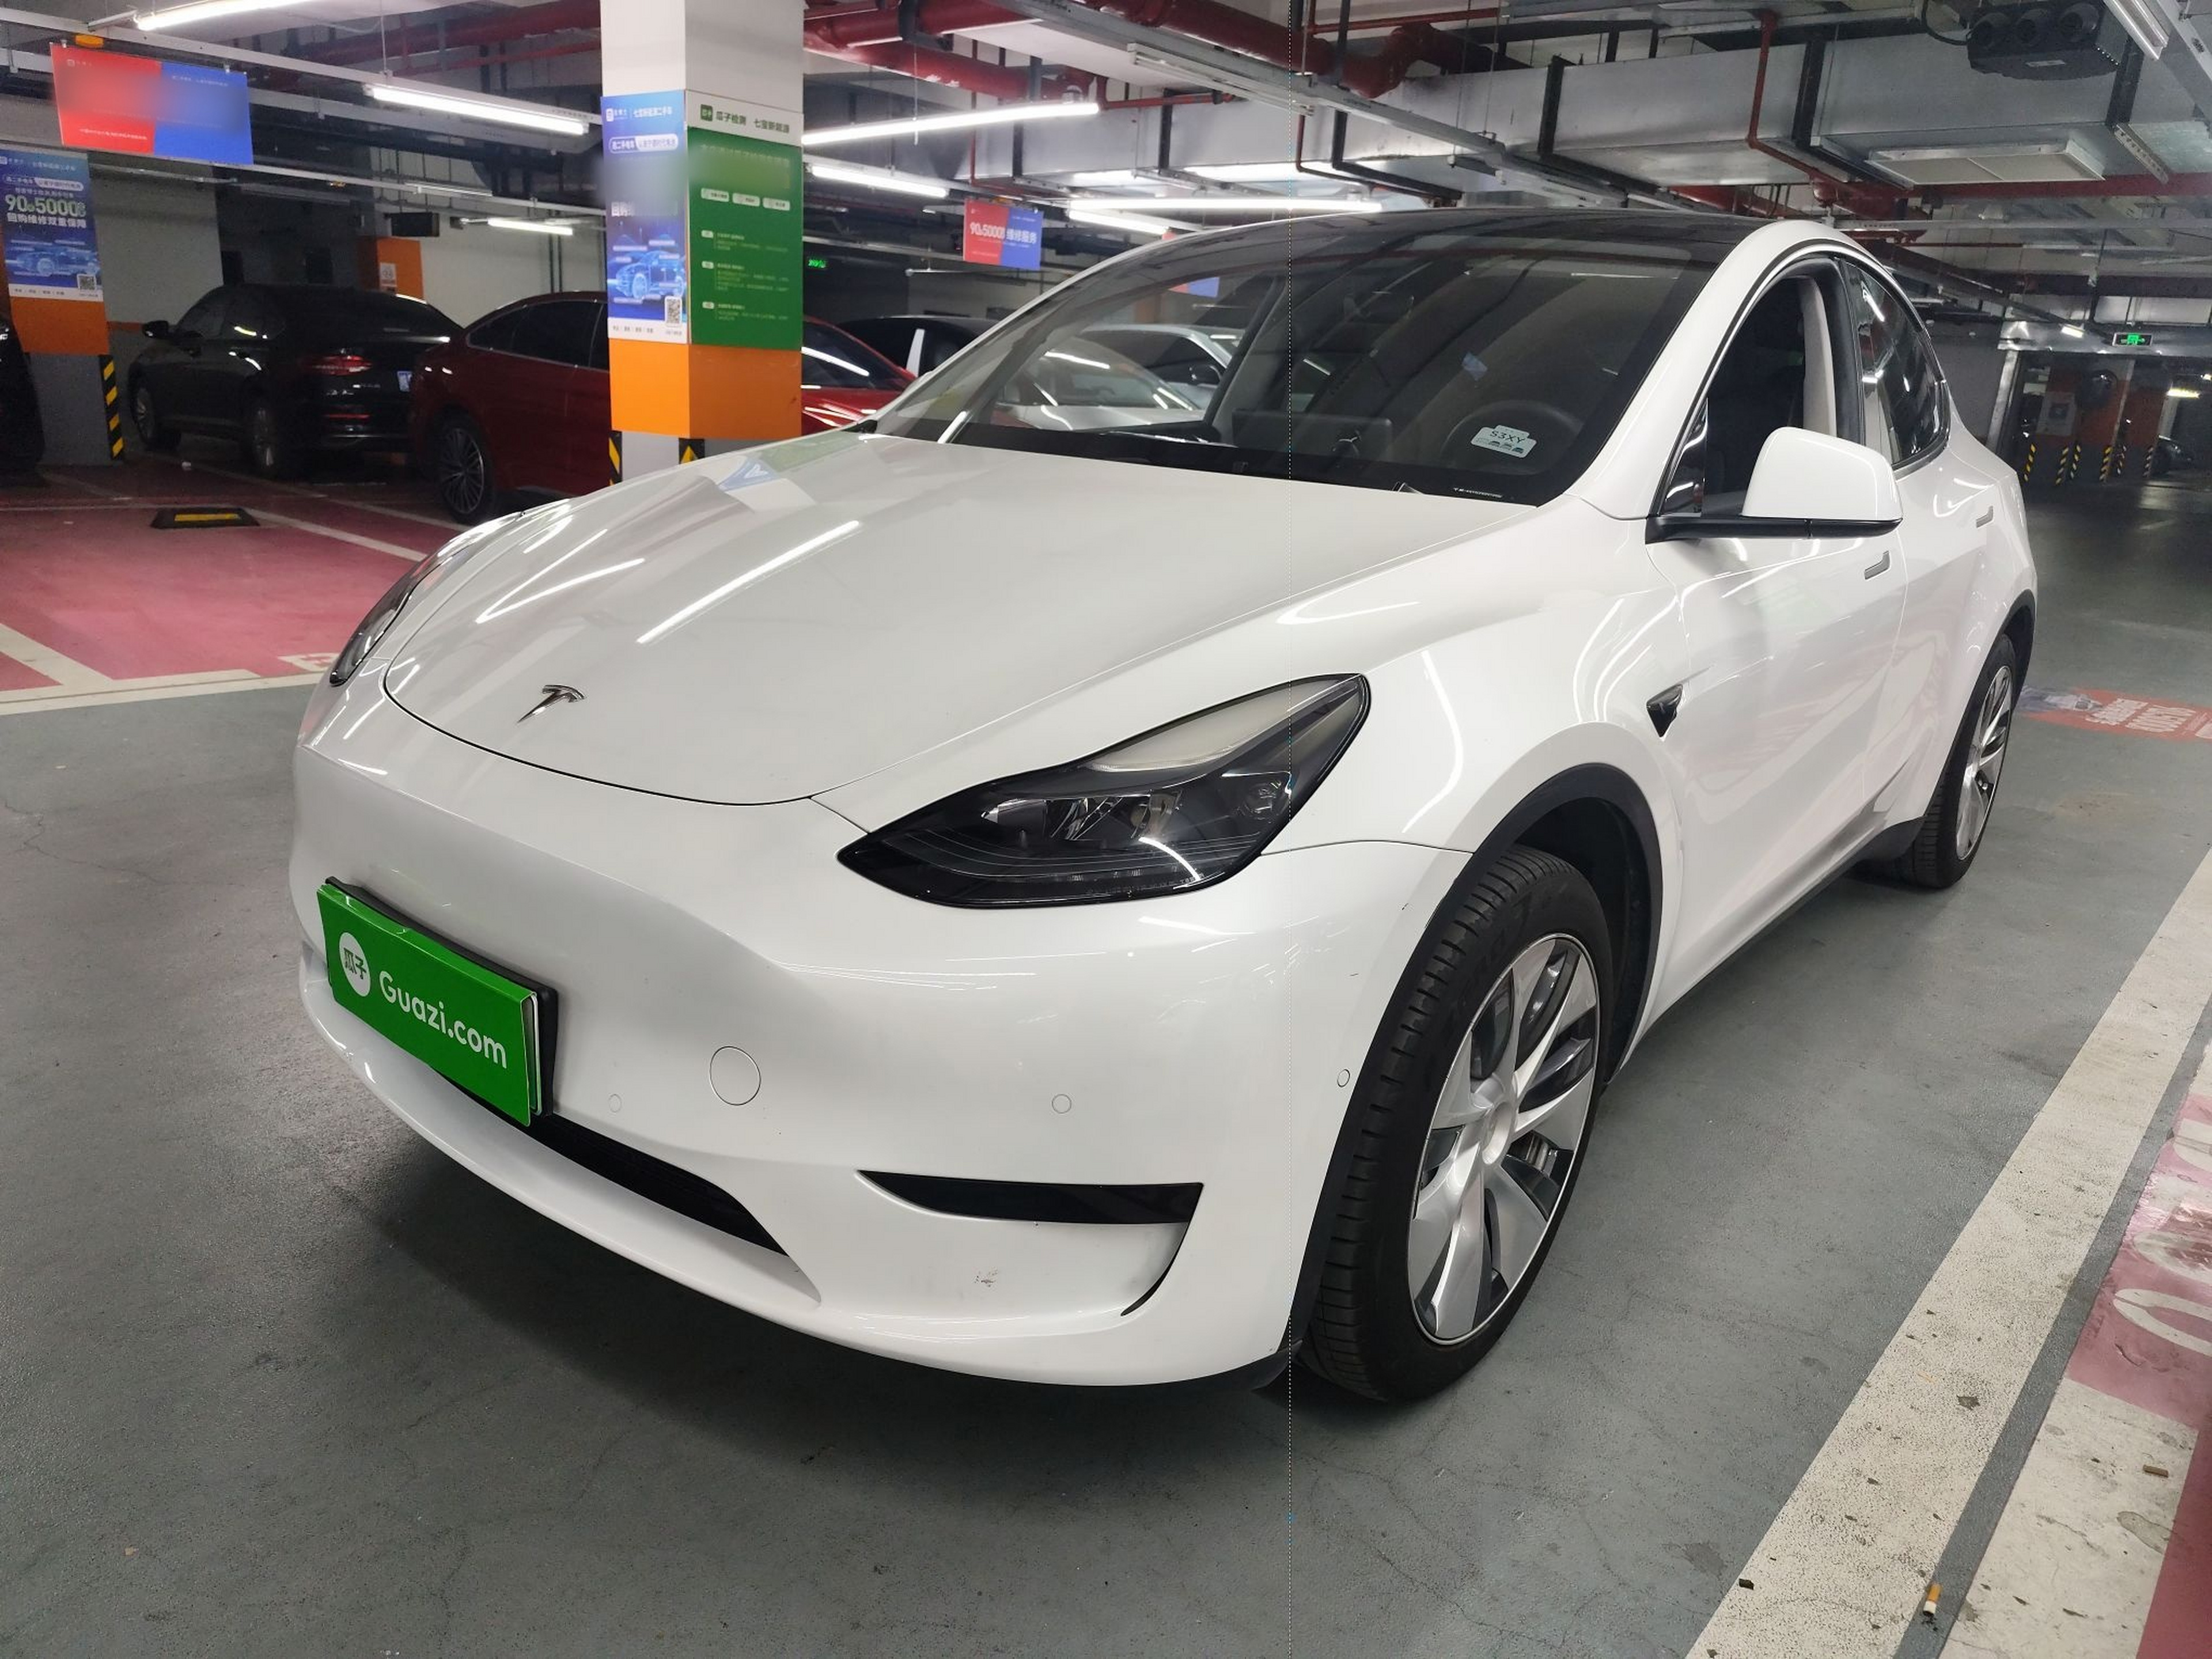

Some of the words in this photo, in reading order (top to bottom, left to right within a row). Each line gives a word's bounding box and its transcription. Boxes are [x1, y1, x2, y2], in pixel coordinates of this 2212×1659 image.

[717, 111, 747, 126] 瓜子检测
[1490, 430, 1525, 444] S3XY
[380, 971, 507, 1069] Guazi.com
